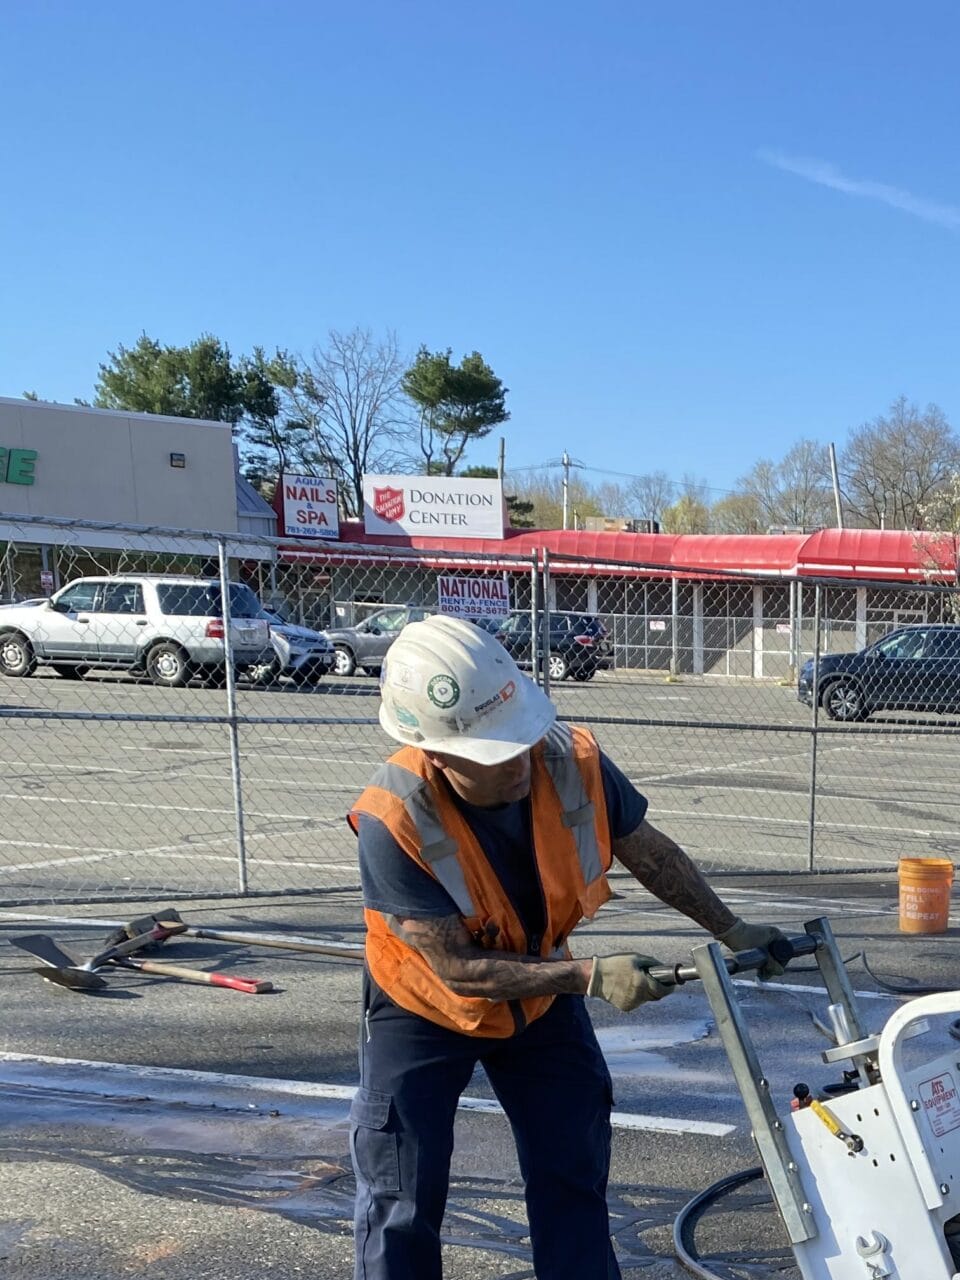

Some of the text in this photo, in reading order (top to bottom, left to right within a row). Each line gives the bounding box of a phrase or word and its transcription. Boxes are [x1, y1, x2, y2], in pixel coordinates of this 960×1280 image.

[294, 476, 325, 487] AQUA
[286, 485, 336, 504] NAILS
[380, 491, 391, 502] THE
[410, 489, 493, 506] DONATION
[306, 502, 314, 510] &
[296, 509, 329, 526] SPA
[408, 510, 468, 525] CENTER
[440, 578, 508, 600] NATIONAL
[440, 597, 508, 608] RENT-A-FENCE
[441, 604, 508, 615] 800-352-5675
[931, 1080, 945, 1097] ATS
[924, 1088, 956, 1110] EQUIPMENT
